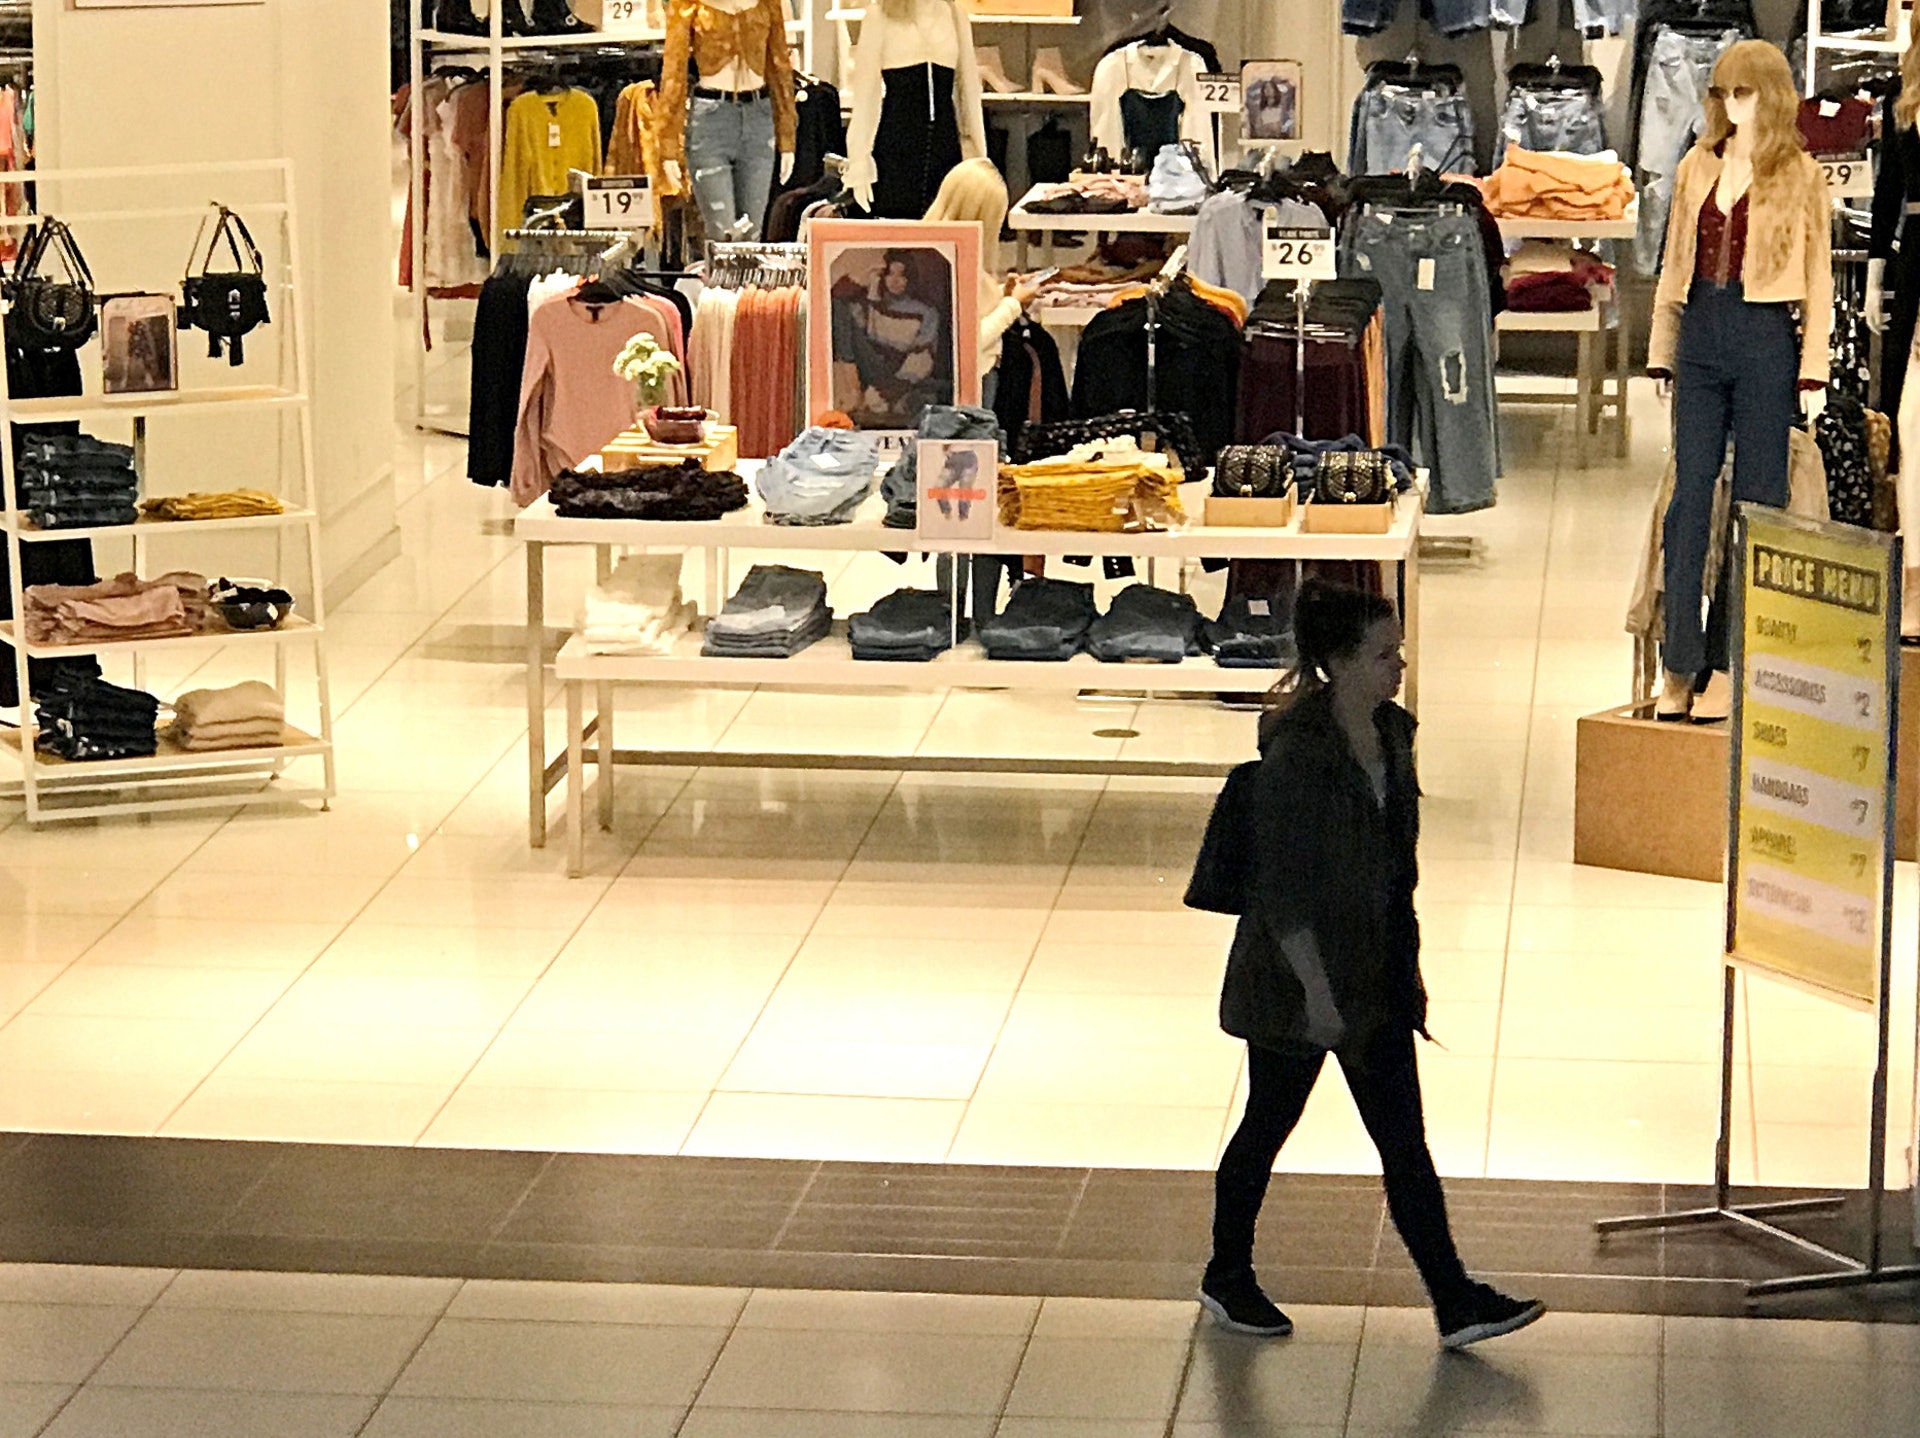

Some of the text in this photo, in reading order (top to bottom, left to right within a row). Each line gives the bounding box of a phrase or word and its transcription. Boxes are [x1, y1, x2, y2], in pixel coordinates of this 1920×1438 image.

[1757, 551, 1876, 608] PRICE MENU
[1754, 668, 1827, 704] ACCESSORIES
[1751, 772, 1810, 808] HANDBAGS
